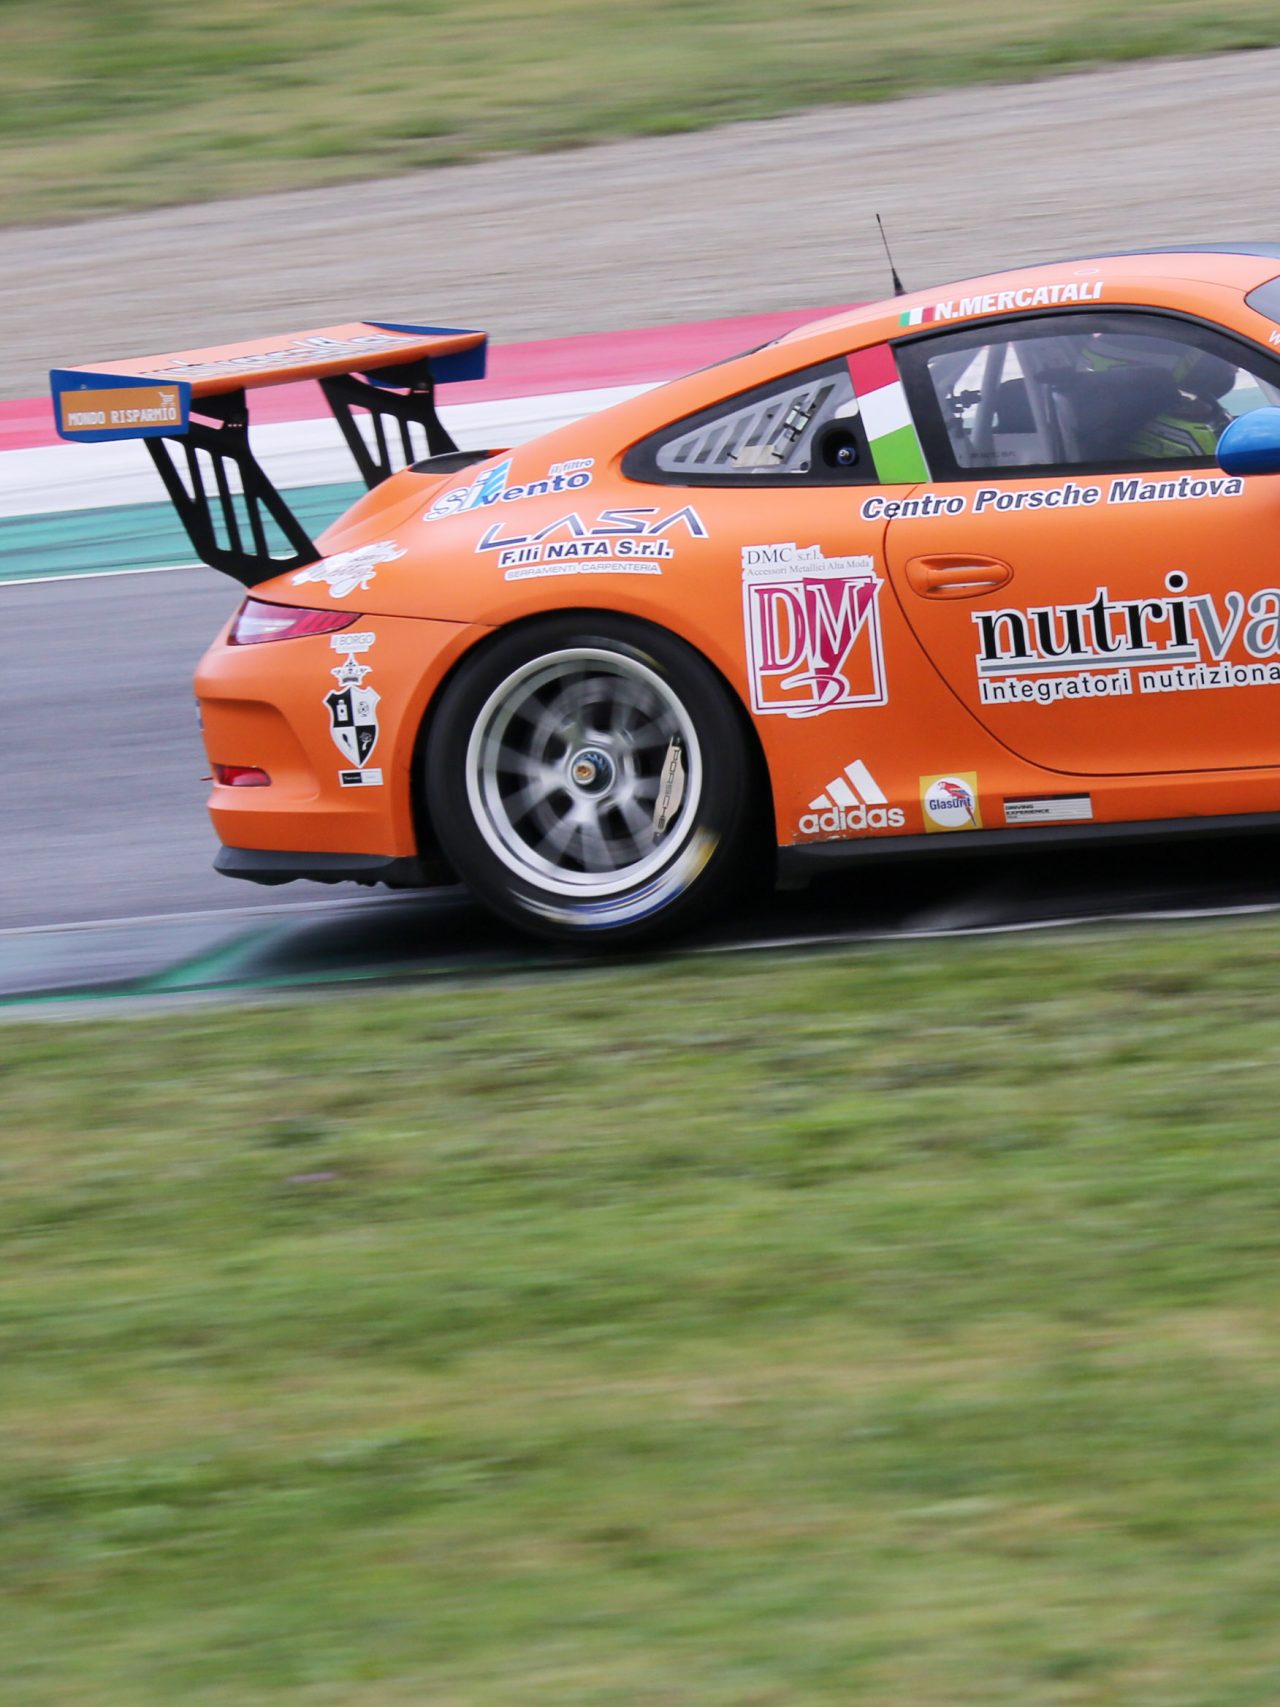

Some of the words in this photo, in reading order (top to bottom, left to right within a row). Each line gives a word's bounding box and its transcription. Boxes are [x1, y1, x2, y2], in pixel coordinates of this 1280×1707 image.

[934, 282, 1104, 321] N.MERCATALI
[68, 411, 106, 426] MONDO
[110, 407, 177, 424] RISPARMIO
[862, 495, 964, 519] Centro
[975, 484, 1099, 511] Porsche
[1110, 477, 1243, 503] Mantova
[547, 541, 608, 558] NATA
[748, 548, 792, 565] DMC
[507, 564, 577, 579] SERRAMENTI
[581, 561, 660, 574] CARPENTERIA
[982, 672, 1130, 700] Integratori
[656, 748, 681, 830] PORSCHE
[929, 796, 971, 811] Glasurit
[799, 802, 905, 834] adidas
